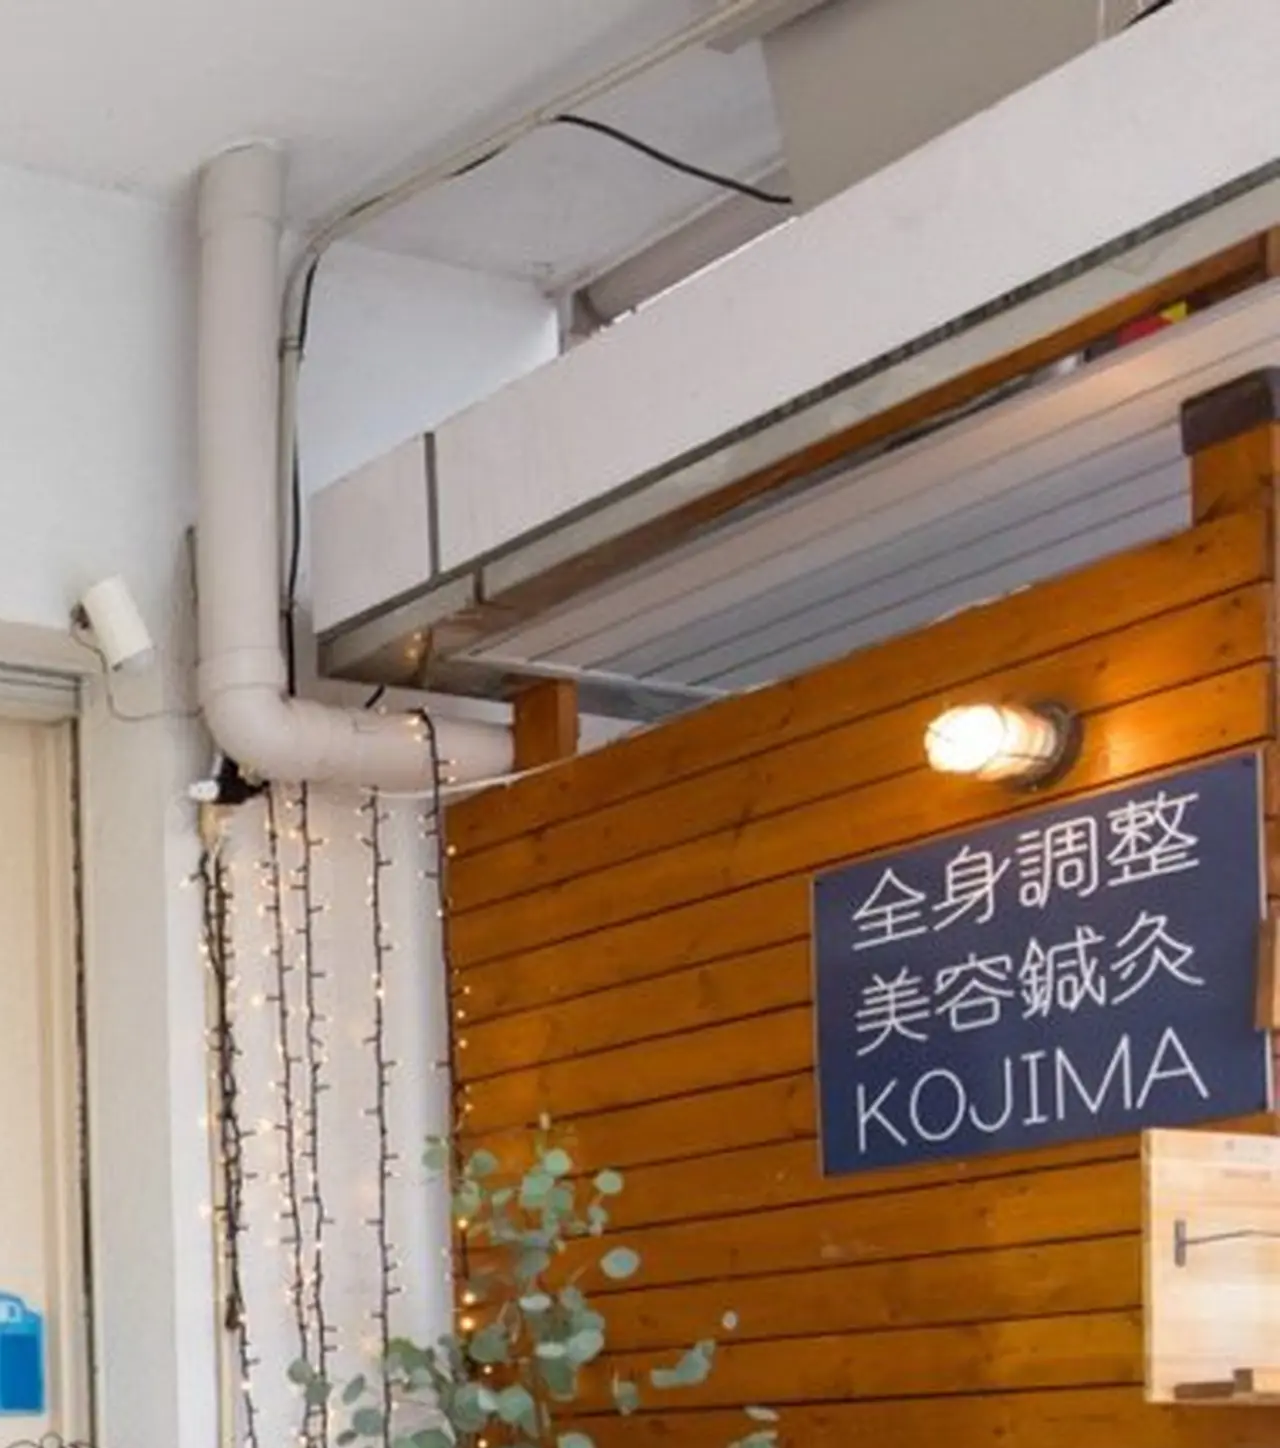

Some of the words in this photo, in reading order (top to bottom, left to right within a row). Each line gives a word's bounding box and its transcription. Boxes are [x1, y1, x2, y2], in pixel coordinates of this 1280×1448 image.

[852, 791, 1200, 950] 全身調整
[854, 911, 1204, 1057] 美容鍼灸
[856, 1027, 1210, 1153] KOJIMA
